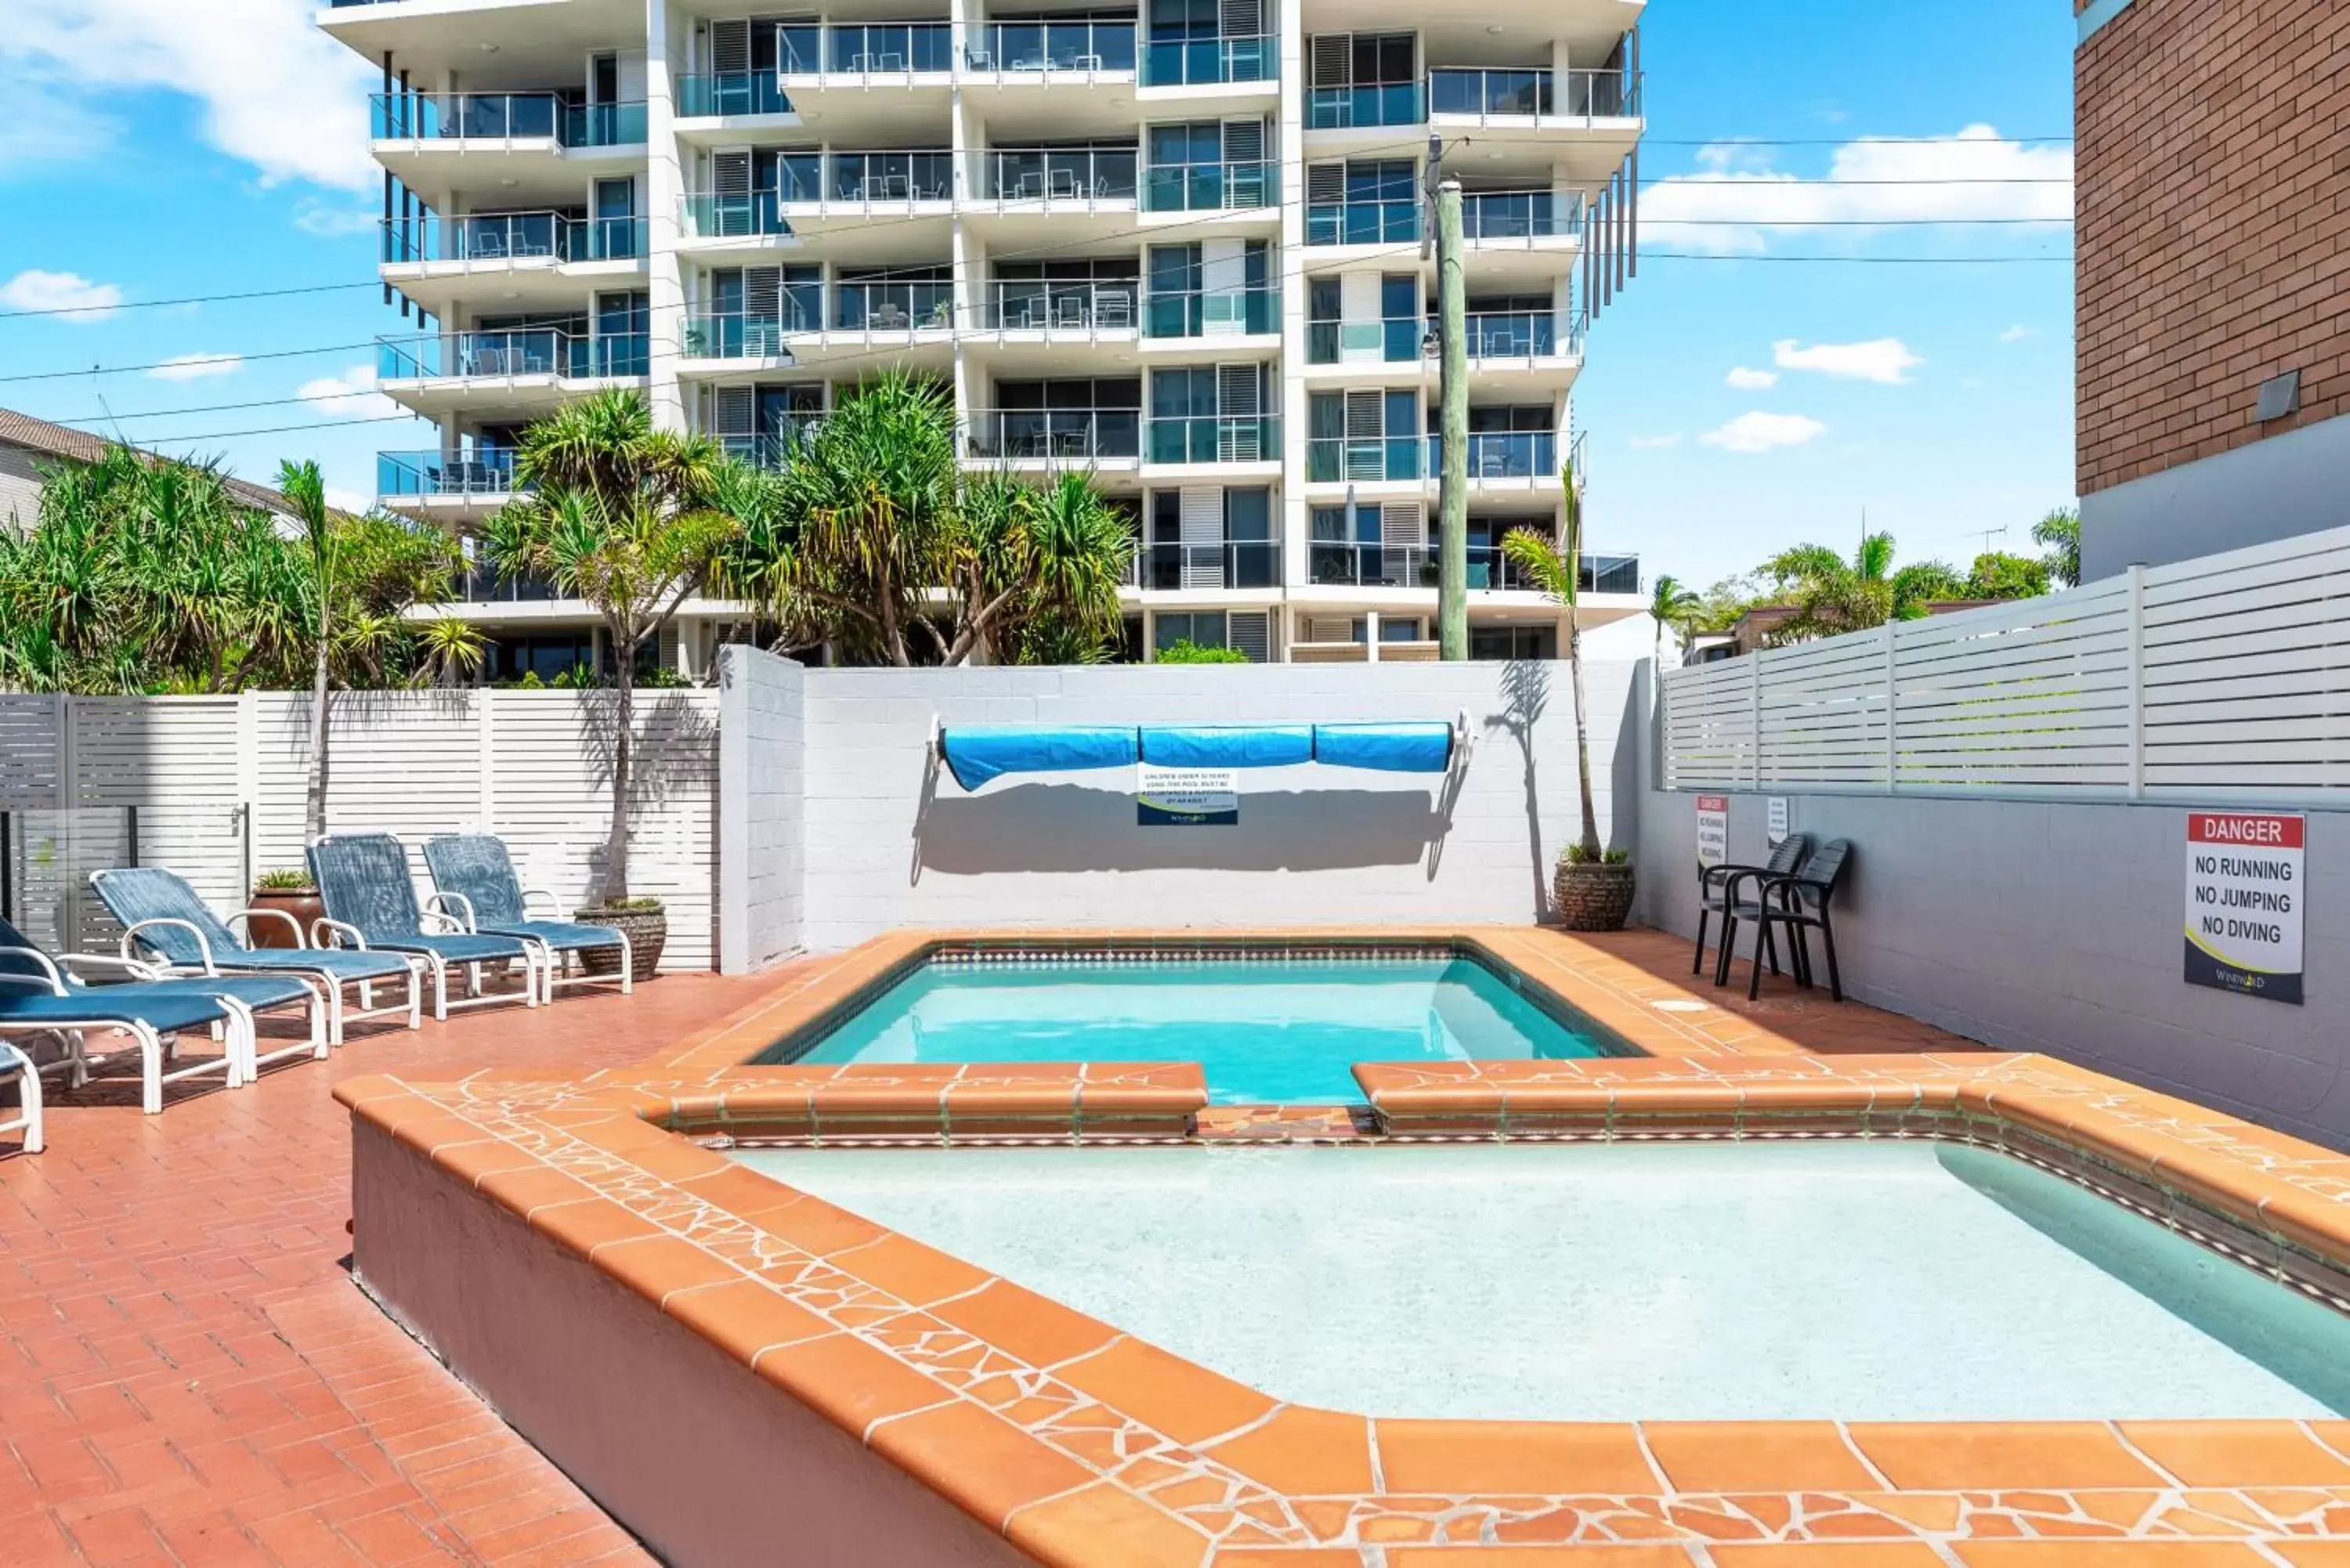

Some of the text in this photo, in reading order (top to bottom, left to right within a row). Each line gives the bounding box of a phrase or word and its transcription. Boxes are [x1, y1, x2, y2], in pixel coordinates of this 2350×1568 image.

[2205, 818, 2282, 842] DANGER
[2196, 856, 2292, 881] NO RUNNING
[2196, 886, 2290, 912] NO JUMPING
[2203, 916, 2280, 943] NO DIVING
